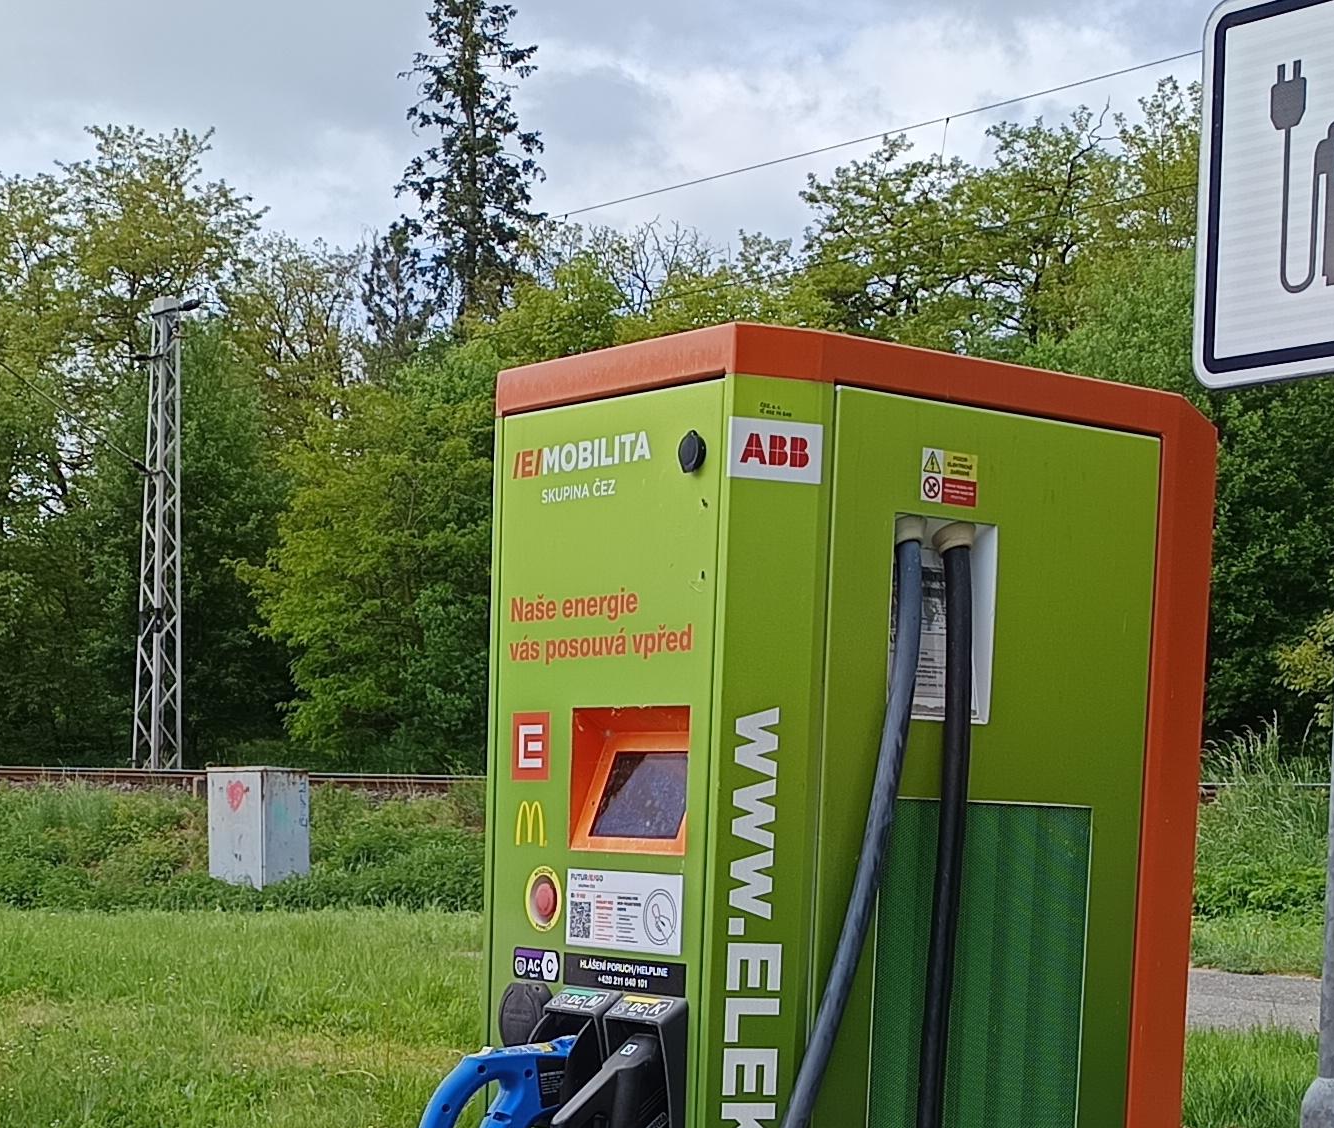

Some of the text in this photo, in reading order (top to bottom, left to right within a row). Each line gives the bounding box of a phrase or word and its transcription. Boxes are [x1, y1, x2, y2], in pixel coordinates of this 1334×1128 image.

[740, 432, 809, 468] ABB
[541, 479, 616, 504] SKUPINA ČEZ
[510, 587, 638, 622] Naše energie
[509, 623, 692, 665] vás posouvá vpřed
[518, 724, 543, 768] E
[527, 959, 541, 972] AC
[546, 959, 554, 973] C
[579, 958, 607, 971] HLÁŠENÍ
[613, 976, 624, 986] 211
[567, 994, 586, 1004] DC
[629, 1003, 648, 1013] DC
[649, 1004, 667, 1015] K
